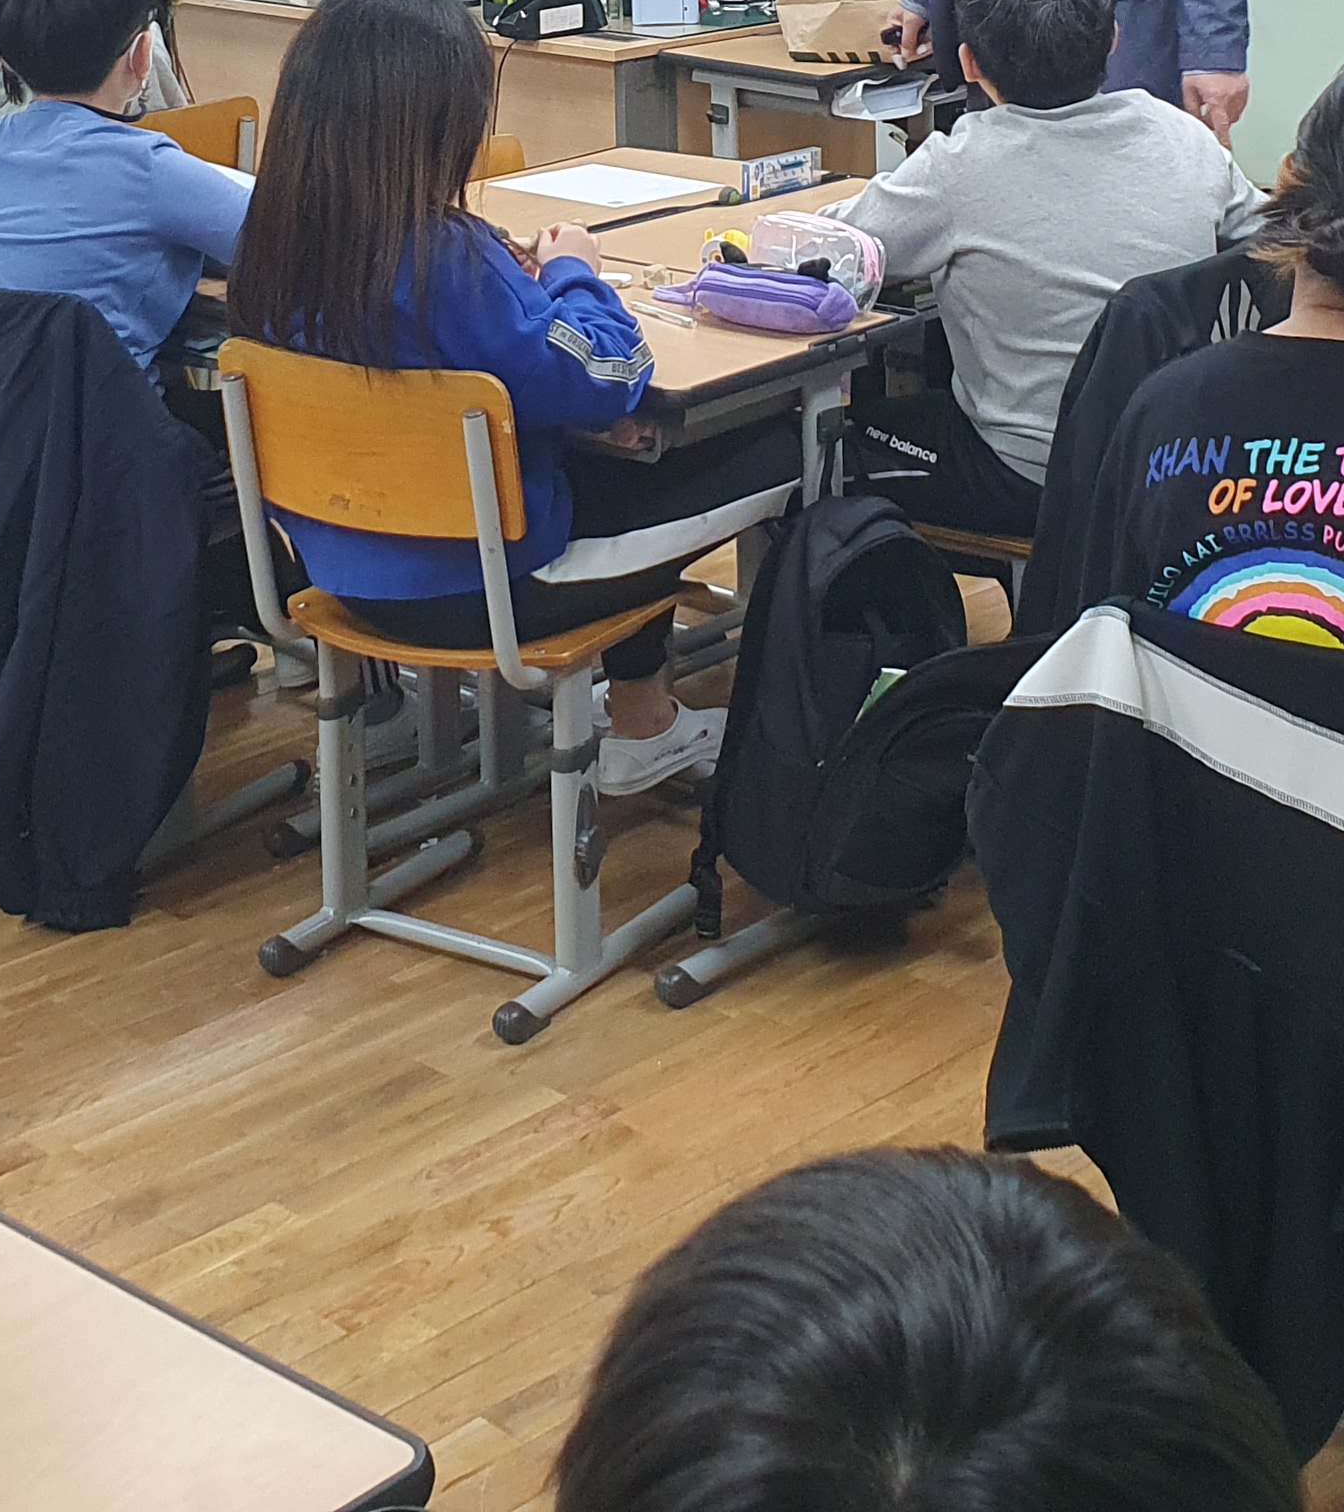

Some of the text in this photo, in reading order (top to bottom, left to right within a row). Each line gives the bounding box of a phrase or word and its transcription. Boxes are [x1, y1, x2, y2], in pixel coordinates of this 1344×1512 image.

[865, 426, 937, 463] new balance
[1244, 437, 1325, 475] THE
[1208, 478, 1257, 514] OF
